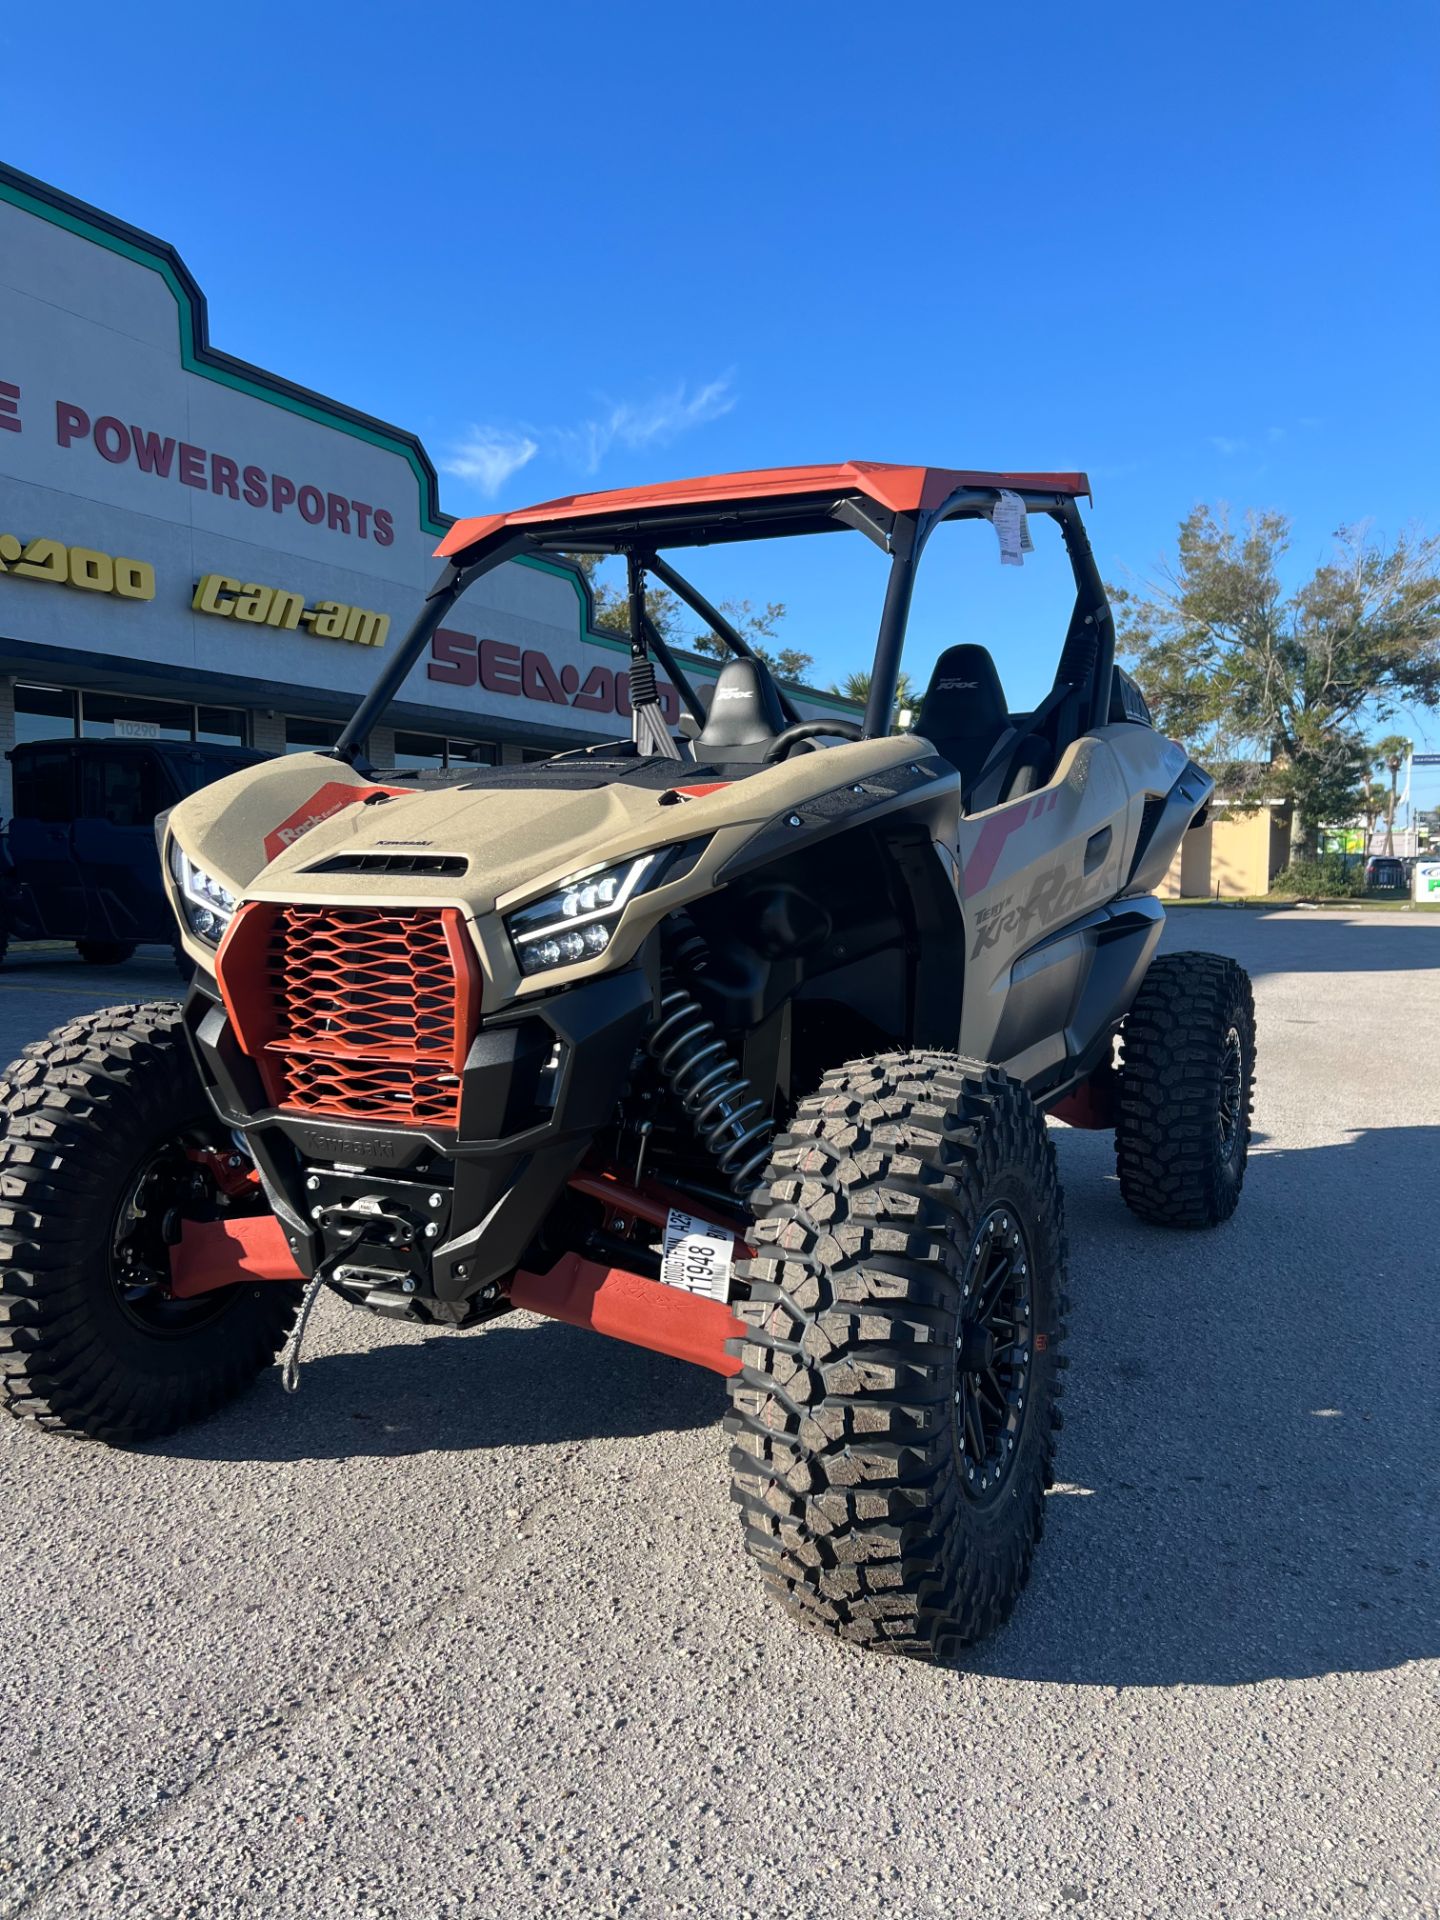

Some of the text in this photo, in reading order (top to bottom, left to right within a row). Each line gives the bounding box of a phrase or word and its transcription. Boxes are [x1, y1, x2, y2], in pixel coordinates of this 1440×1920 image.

[56, 400, 395, 547] POWERSPORTS
[118, 722, 157, 738] 10290
[277, 815, 323, 846] Rock
[303, 1130, 395, 1158] Kawasaki
[686, 1246, 716, 1292] 11948
